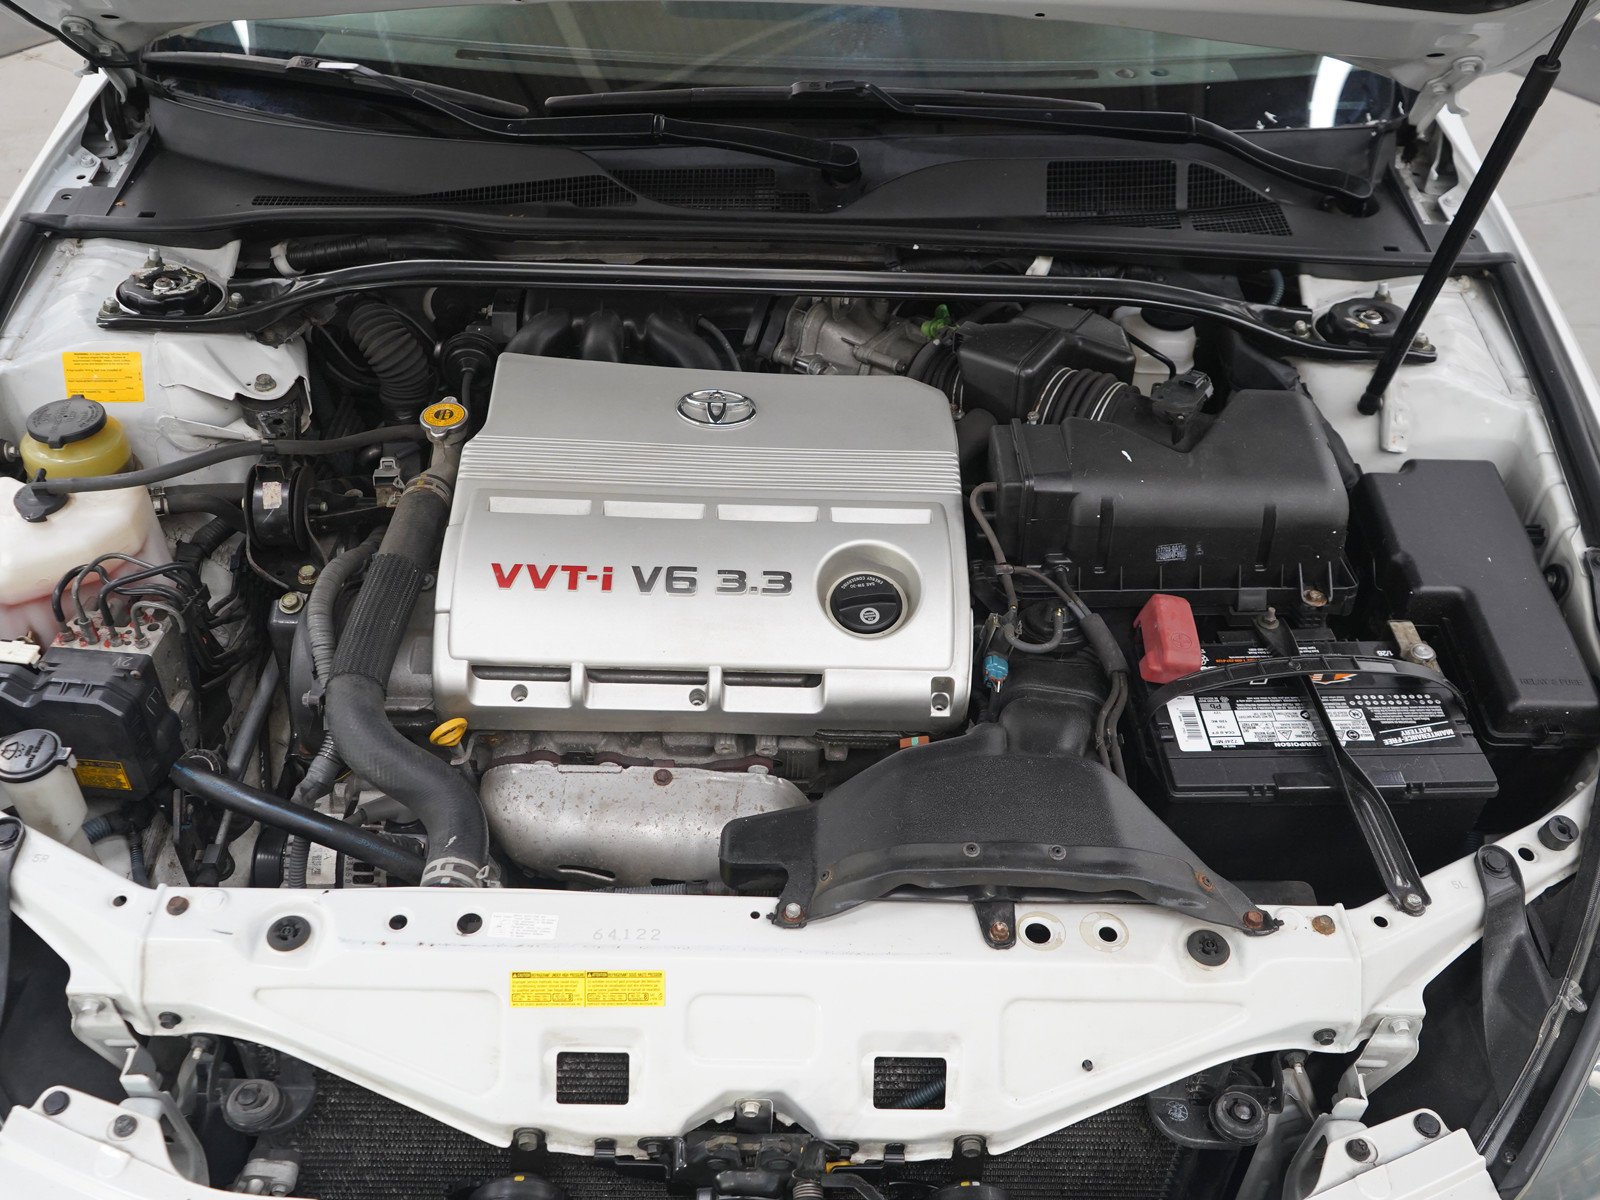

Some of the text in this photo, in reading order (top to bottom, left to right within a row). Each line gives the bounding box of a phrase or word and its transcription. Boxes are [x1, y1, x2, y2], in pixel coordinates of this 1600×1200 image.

[491, 562, 793, 597] VVT-i V6 3.3
[865, 581, 876, 589] SAE
[1382, 728, 1455, 746] MAINTENANCE-FREE
[1400, 726, 1433, 736] BATTERY
